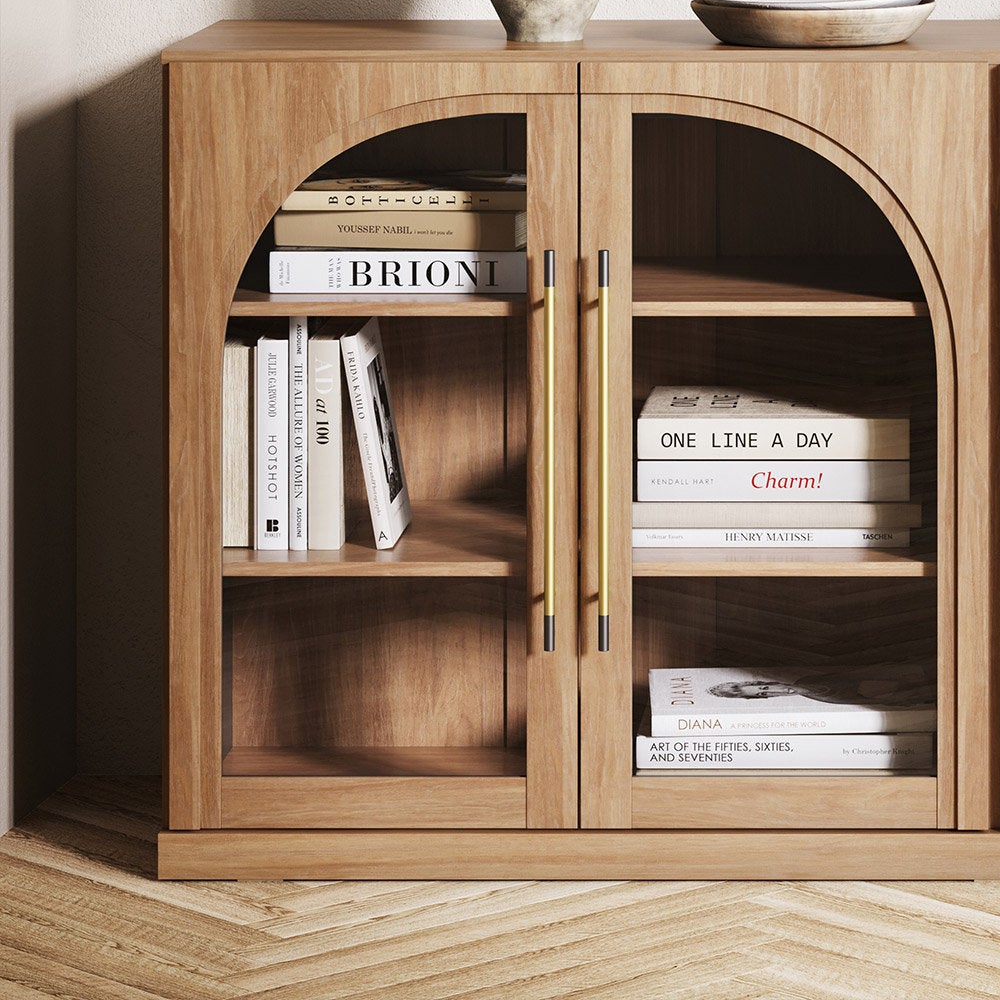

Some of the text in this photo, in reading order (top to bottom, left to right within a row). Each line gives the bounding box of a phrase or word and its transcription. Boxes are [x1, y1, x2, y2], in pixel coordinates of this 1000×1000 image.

[328, 195, 490, 206] BOTTICELLI
[337, 225, 380, 234] YOUSSEF
[382, 226, 412, 235] NABIL
[349, 260, 499, 287] BRIONI
[268, 352, 277, 418] JULIE GARWOOD
[347, 351, 366, 420] FRIDA KAHLO
[314, 358, 333, 444] AD at 100
[294, 364, 303, 499] THE ALLURE OF WOMEN
[660, 433, 833, 448] ONE LINE A DAY
[268, 436, 278, 500] HOTSHOT
[750, 472, 823, 489] Charm!
[724, 532, 814, 542] HENRY MATISSE
[671, 676, 694, 705] DIANA
[678, 719, 722, 730] DIANA
[650, 742, 794, 753] ART OF THE FIFTIES, SIXTIES,
[650, 754, 733, 762] AND SEVENTIES
